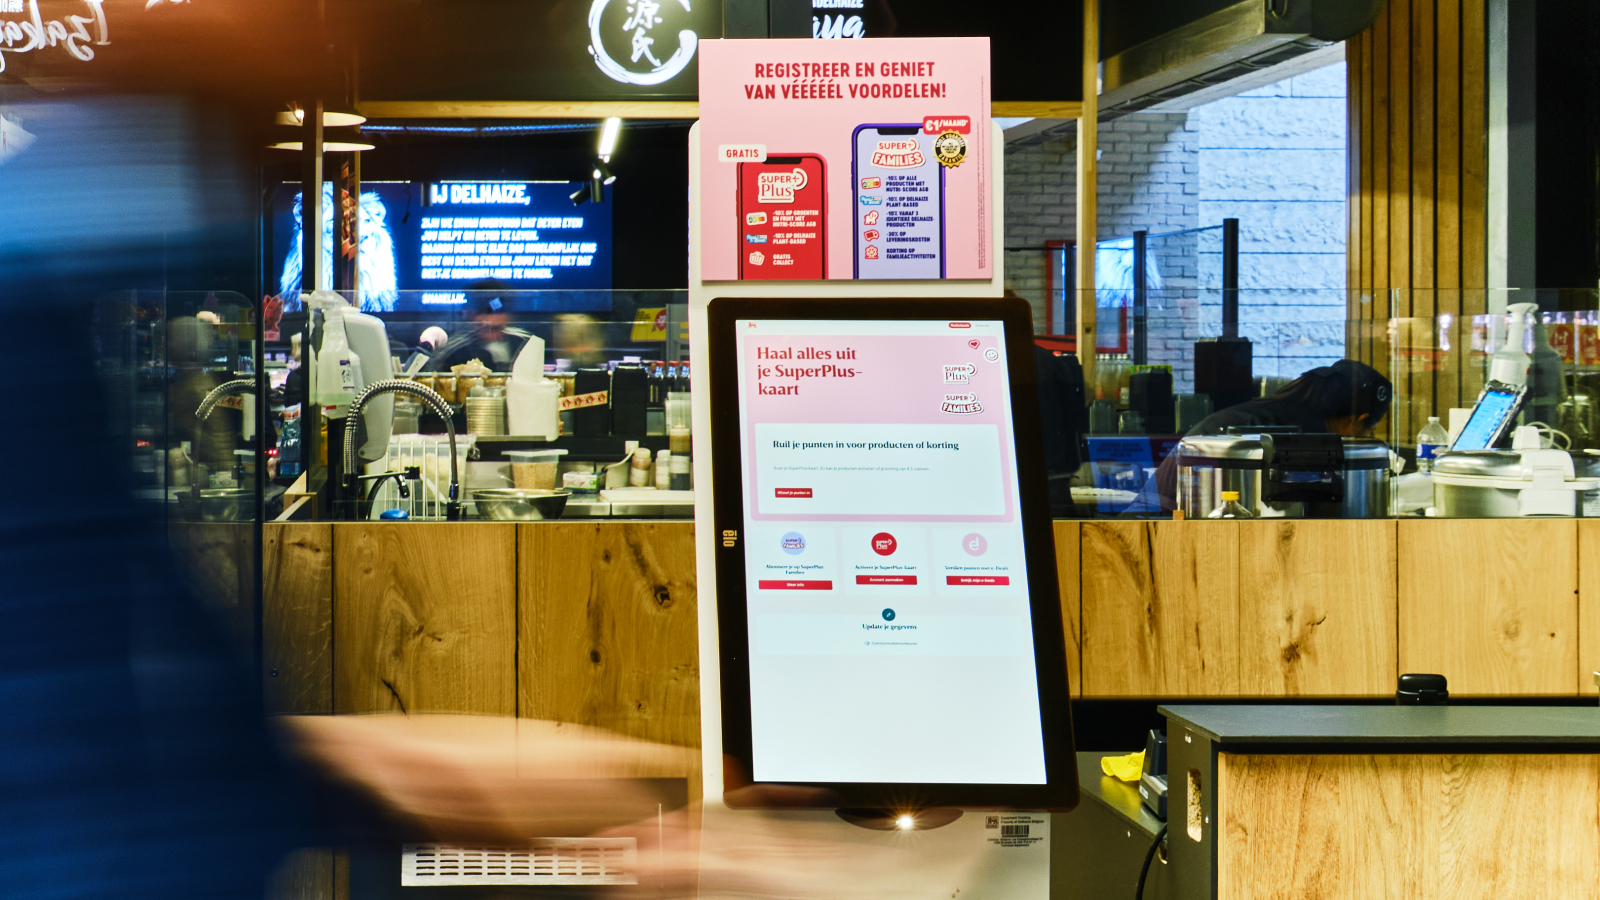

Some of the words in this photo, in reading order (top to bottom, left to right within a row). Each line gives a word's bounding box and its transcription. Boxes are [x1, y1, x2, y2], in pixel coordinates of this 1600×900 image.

[755, 62, 850, 78] REGISTREER
[855, 62, 875, 78] EN
[880, 61, 935, 77] GENIET
[744, 84, 775, 99] VAN
[781, 78, 844, 99] VÉÉÉÉÉL
[849, 83, 946, 99] VOORDELEN!
[726, 149, 759, 158] GRATIS
[873, 152, 924, 168] FAMILIES
[451, 184, 531, 206] DELHAIZE,
[761, 184, 792, 197] Plus
[757, 347, 792, 360] Haal
[797, 347, 832, 360] alles
[836, 347, 857, 360] uit
[757, 365, 771, 381] je
[775, 364, 863, 381] SuperPlus-
[946, 372, 967, 380] Plus
[758, 382, 800, 395] kaart
[942, 402, 983, 414] FAMILIES
[792, 441, 801, 450] je
[802, 442, 834, 450] punten
[868, 442, 914, 450] producten
[926, 441, 960, 451] korting
